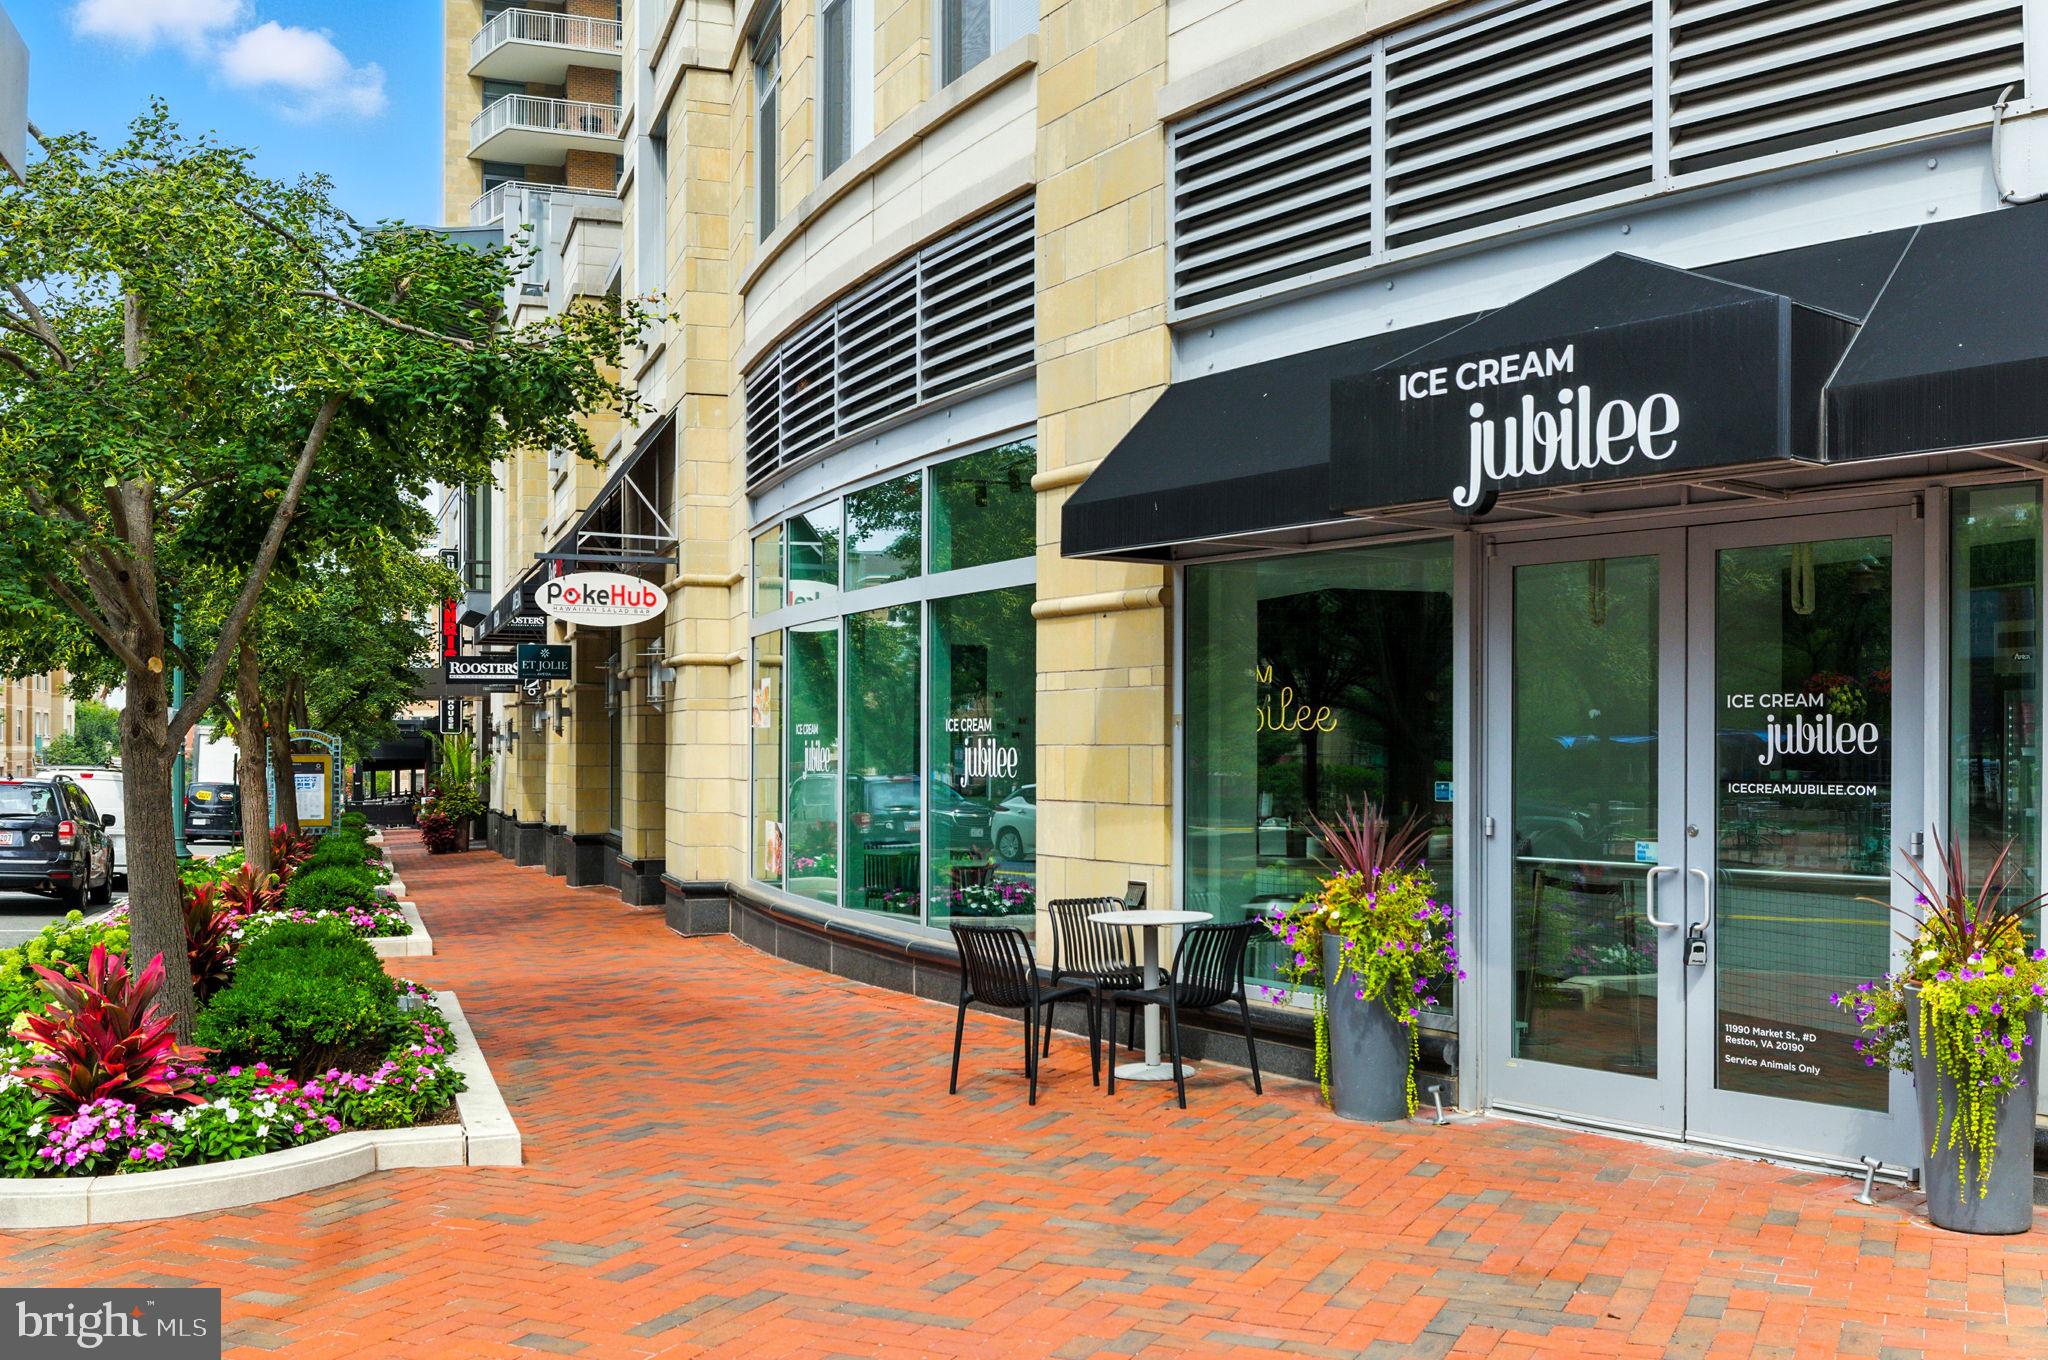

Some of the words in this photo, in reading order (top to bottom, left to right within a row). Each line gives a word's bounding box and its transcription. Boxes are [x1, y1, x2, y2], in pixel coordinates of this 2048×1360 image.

[1400, 367, 1448, 401] ICE
[1455, 344, 1574, 391] CREAM
[1453, 385, 1680, 507] jubilee
[547, 583, 657, 607] PokeHub
[522, 660, 535, 670] ET
[536, 660, 569, 672] JOLIE
[1727, 694, 1755, 709] ICE
[1759, 693, 1825, 709] CREAM
[795, 723, 803, 735] ICE
[803, 723, 819, 735] CREAM
[945, 718, 959, 732] ICE
[960, 717, 992, 732] CREAM
[1758, 713, 1879, 766] jubilee
[802, 739, 831, 780] jubilee
[960, 737, 1018, 788] jubilee
[1728, 783, 1877, 796] ICECREAMJUBILEE.COM
[1725, 1024, 1751, 1035] 11990
[1752, 1027, 1784, 1039] Market
[1786, 1031, 1800, 1042] St.,
[1802, 1033, 1817, 1042] #D
[1725, 1035, 1759, 1048] Reston,
[1761, 1040, 1774, 1049] VA
[1776, 1041, 1805, 1053] 20190
[1725, 1054, 1758, 1066] Service
[1760, 1059, 1797, 1072] Animals
[1799, 1064, 1821, 1076] Only
